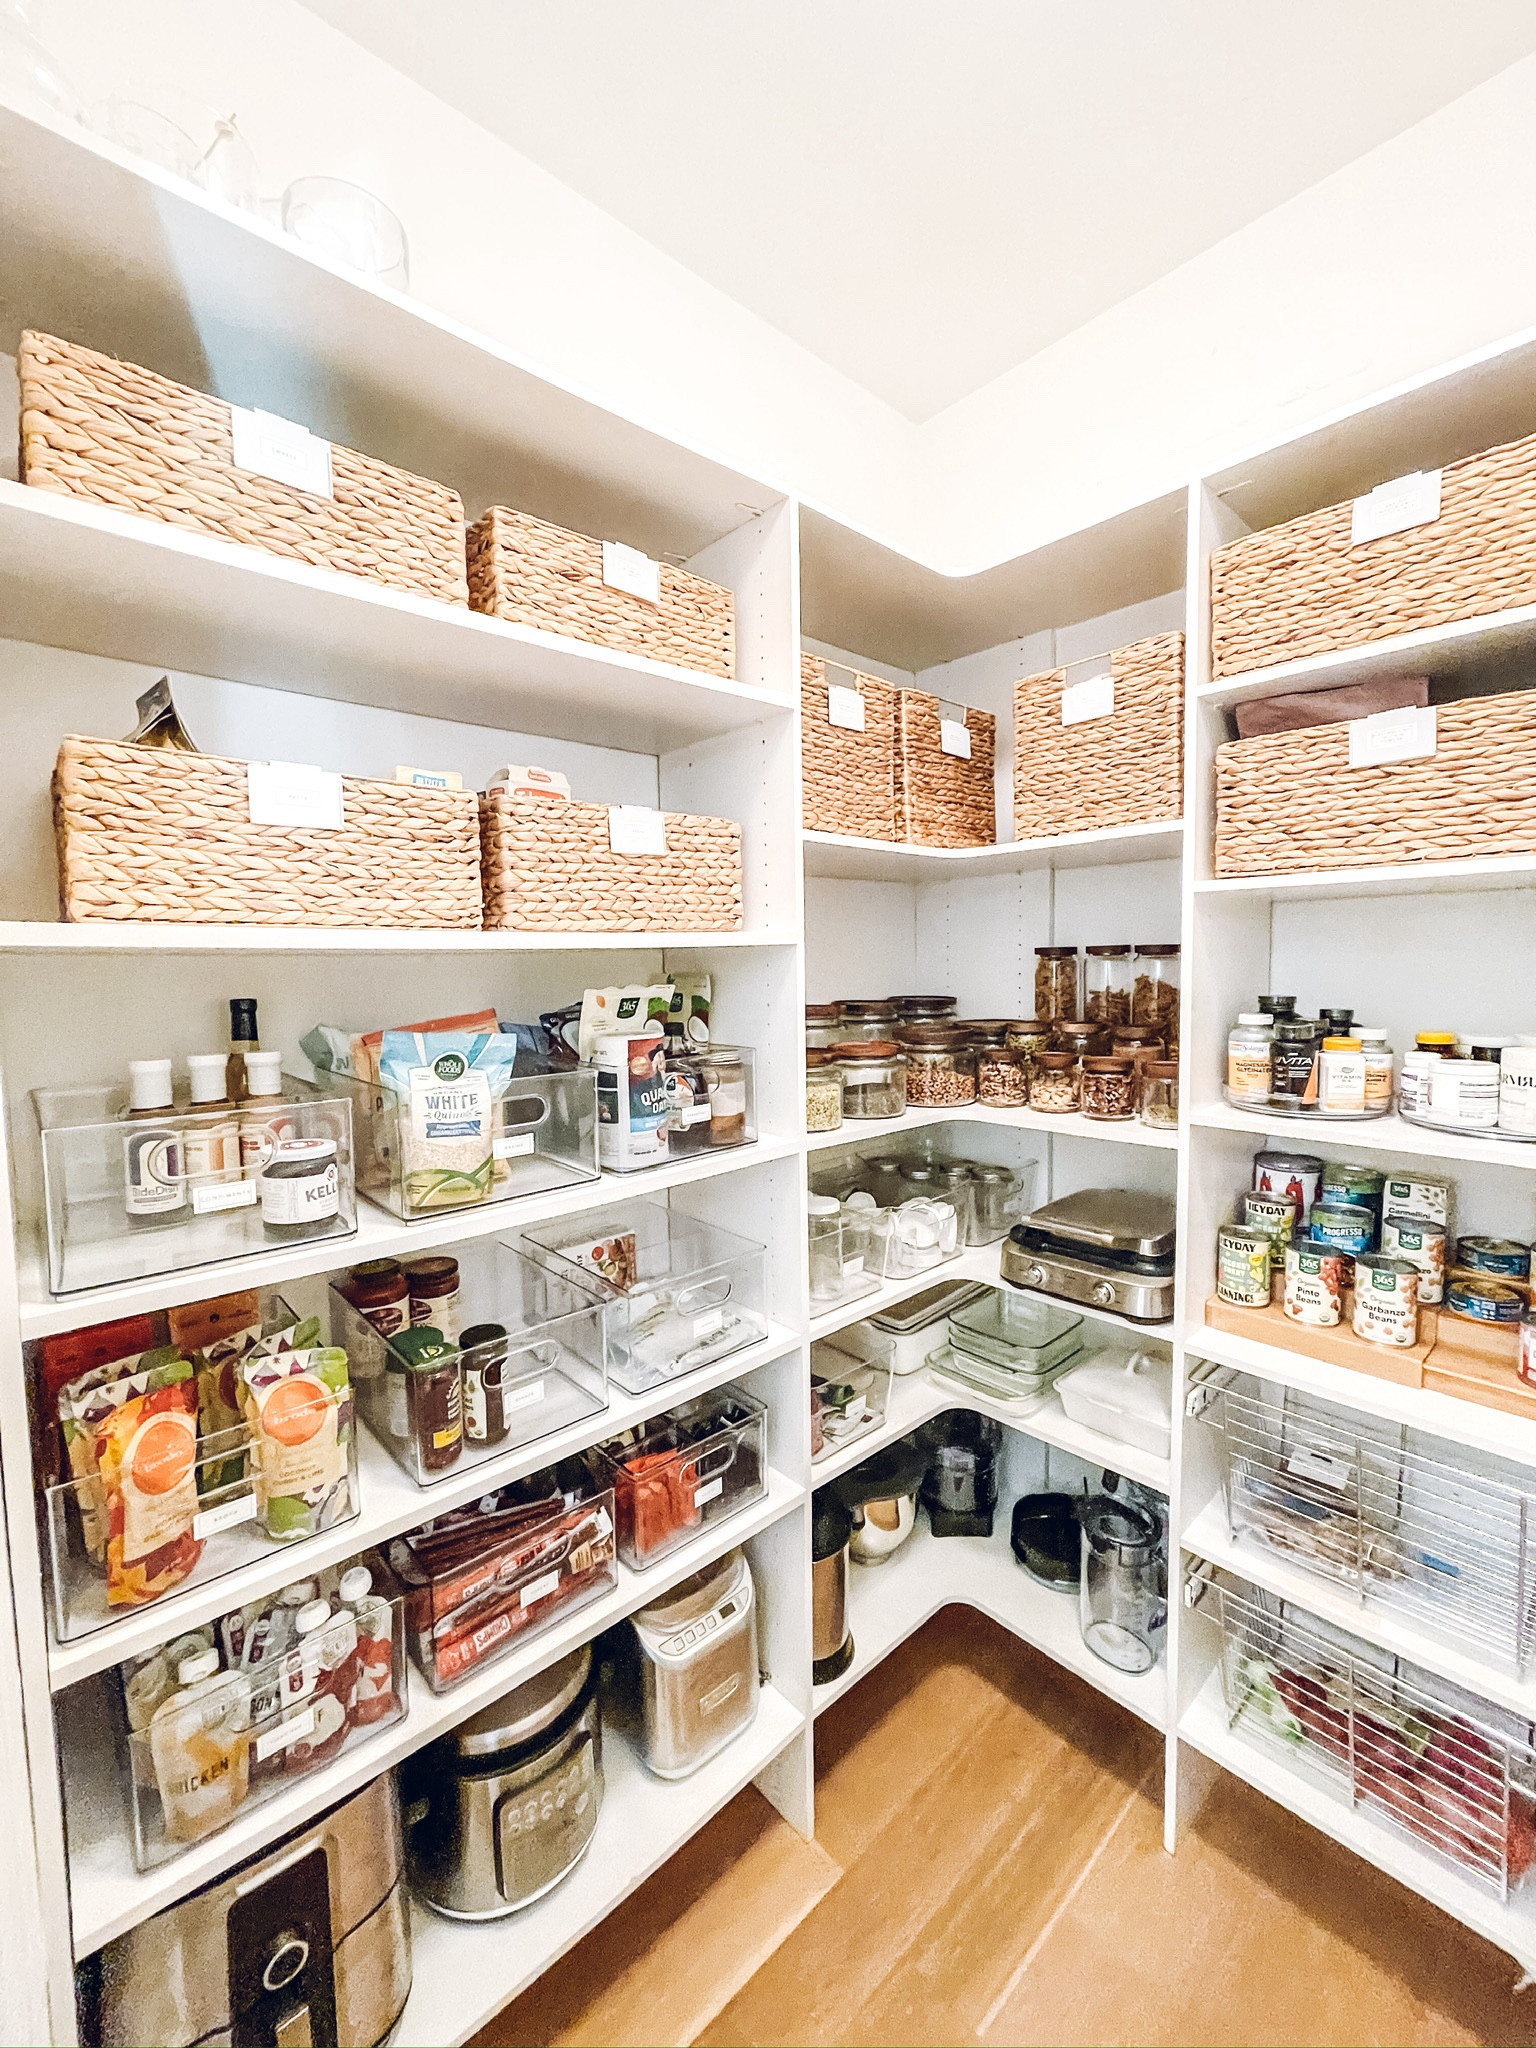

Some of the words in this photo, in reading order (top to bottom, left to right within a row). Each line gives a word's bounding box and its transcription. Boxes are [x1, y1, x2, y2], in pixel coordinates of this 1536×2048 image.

[620, 1001, 637, 1012] 365
[438, 1066, 461, 1074] FOODS
[425, 1093, 479, 1110] WHITE
[640, 1088, 664, 1106] QUA
[1388, 1207, 1431, 1220] Cannellini
[1323, 1227, 1363, 1237] PROGRESSO
[1400, 1234, 1420, 1245] 365
[1300, 1259, 1319, 1270] 365
[1373, 1274, 1395, 1287] 365
[1297, 1286, 1320, 1298] Pinto
[1295, 1293, 1322, 1306] Beans
[1361, 1301, 1406, 1317] Garbanzo
[1368, 1311, 1397, 1325] Beans
[476, 1617, 509, 1648] CHOMPS
